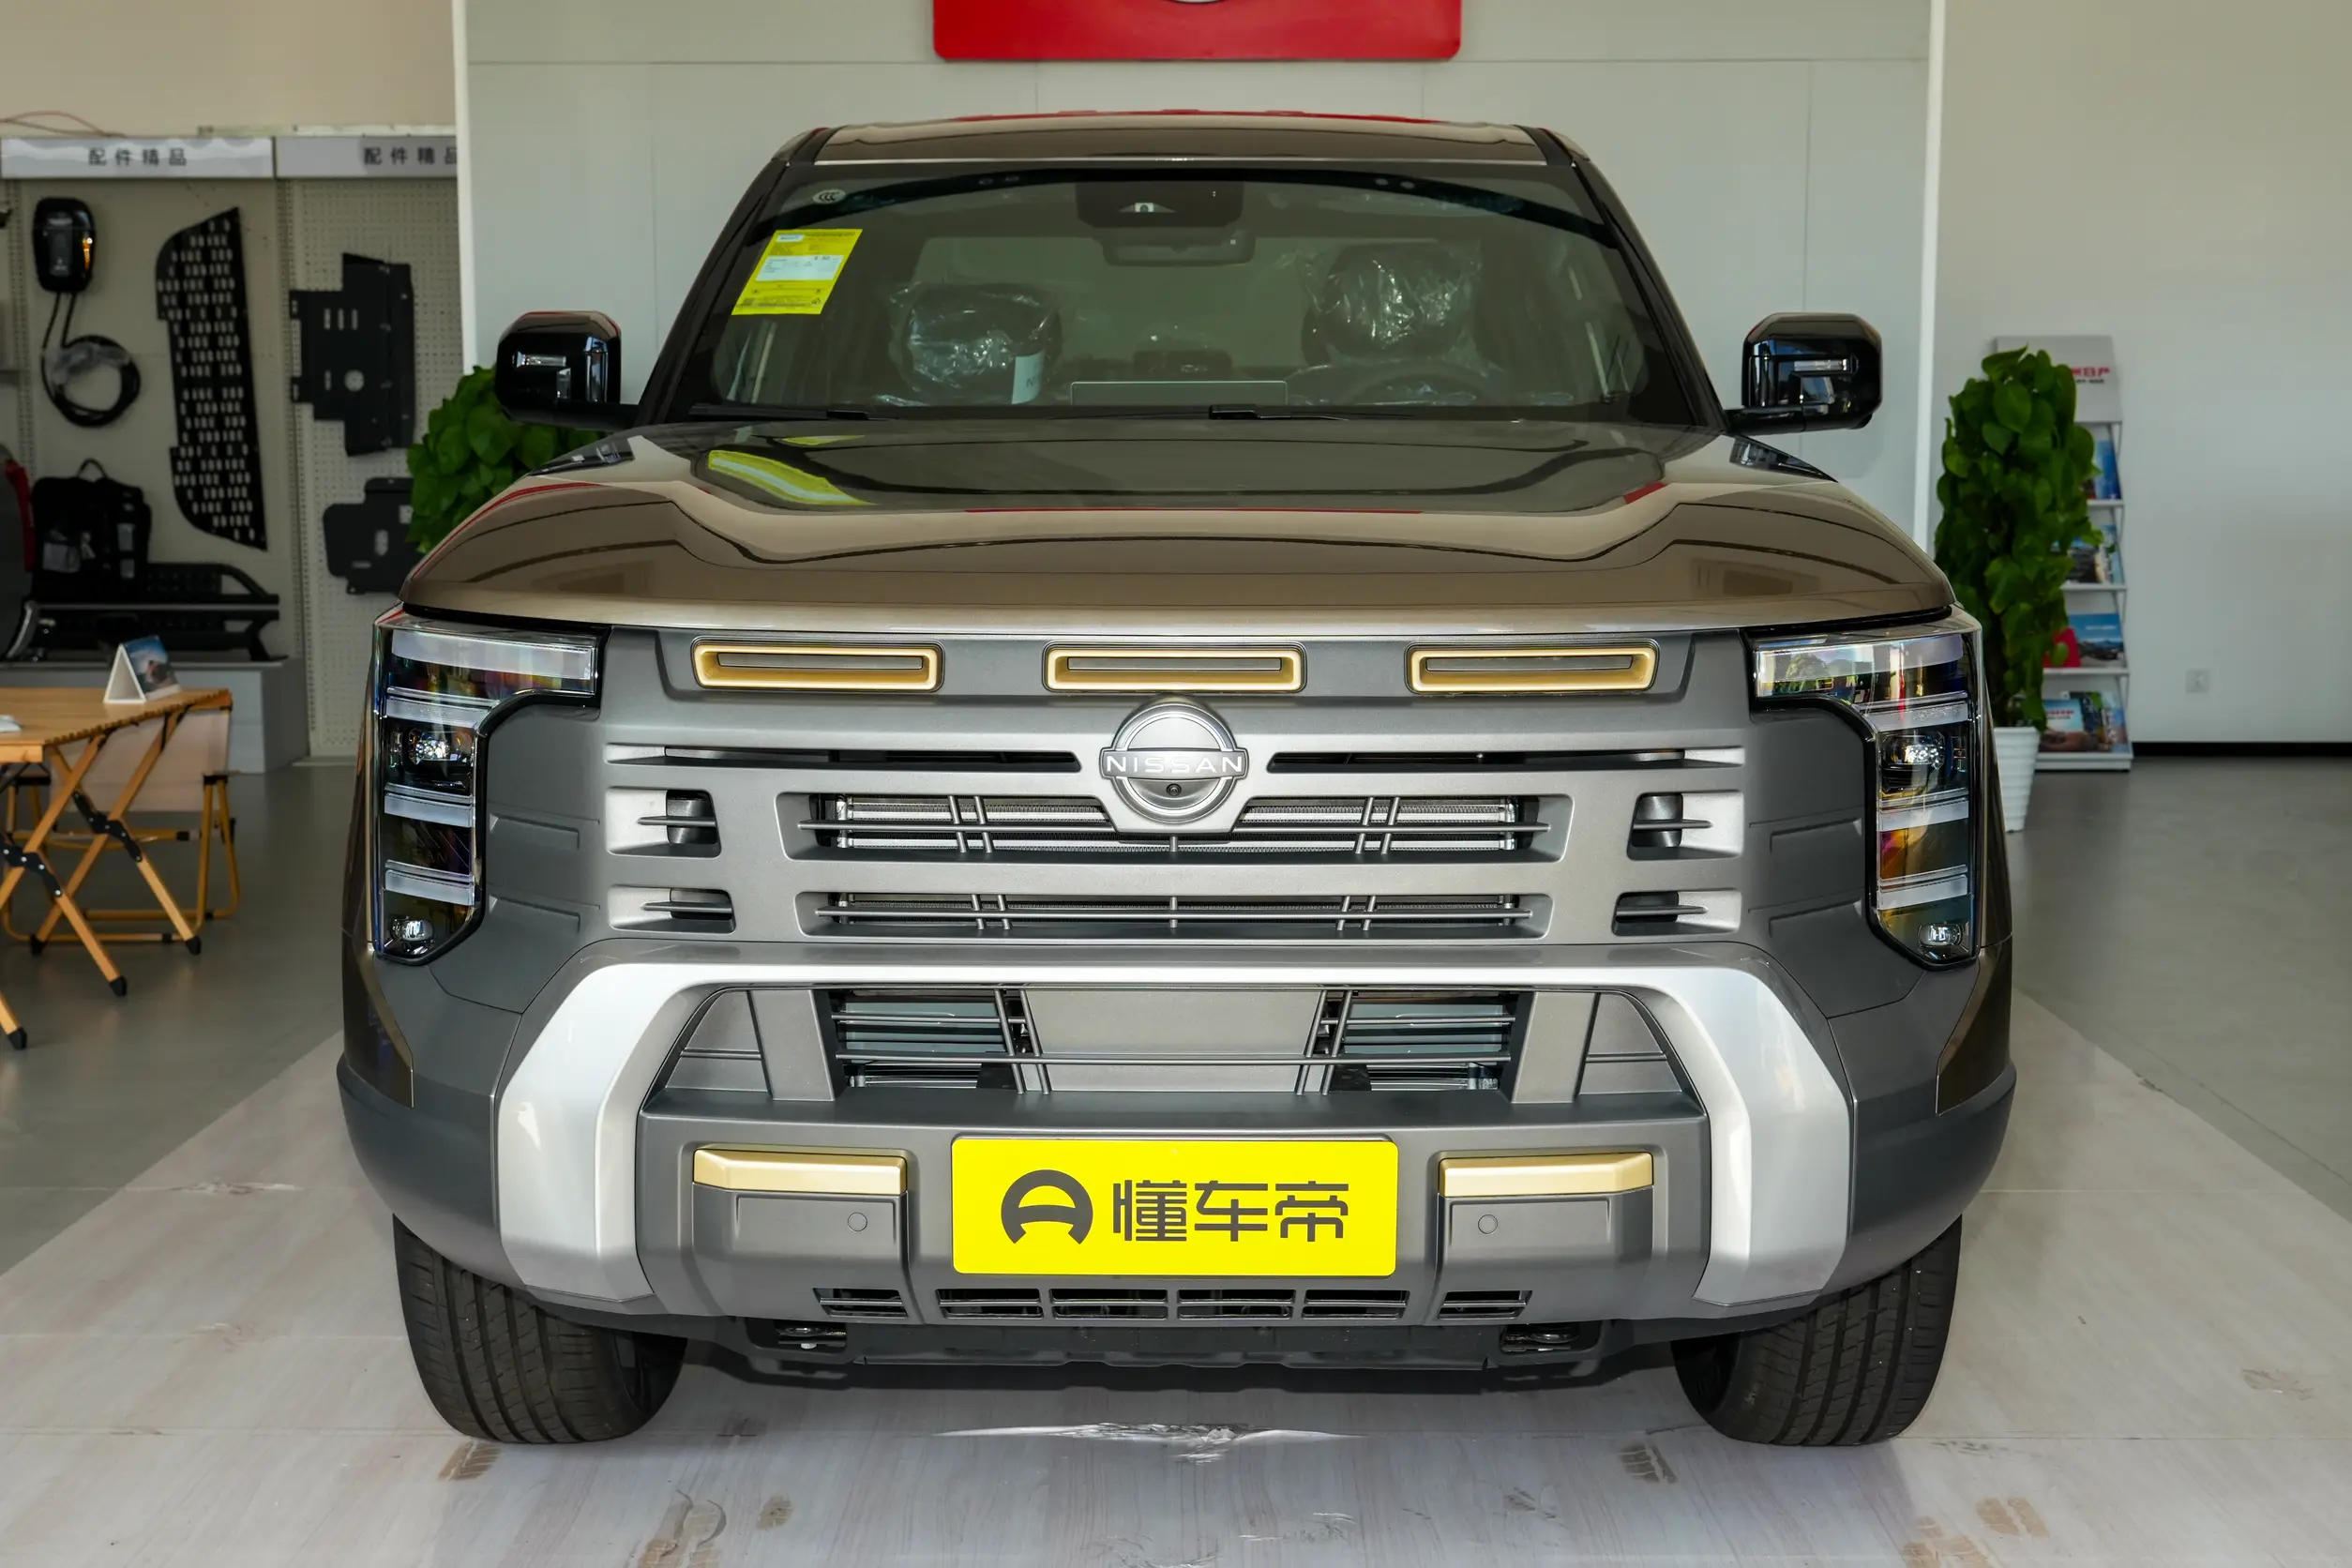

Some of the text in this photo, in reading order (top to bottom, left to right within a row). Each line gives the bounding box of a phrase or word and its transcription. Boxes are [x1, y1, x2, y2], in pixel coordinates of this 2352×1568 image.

[88, 147, 187, 166] 配件精品
[1106, 755, 1243, 774] NISSAN
[1112, 1179, 1349, 1243] 懂车帝
